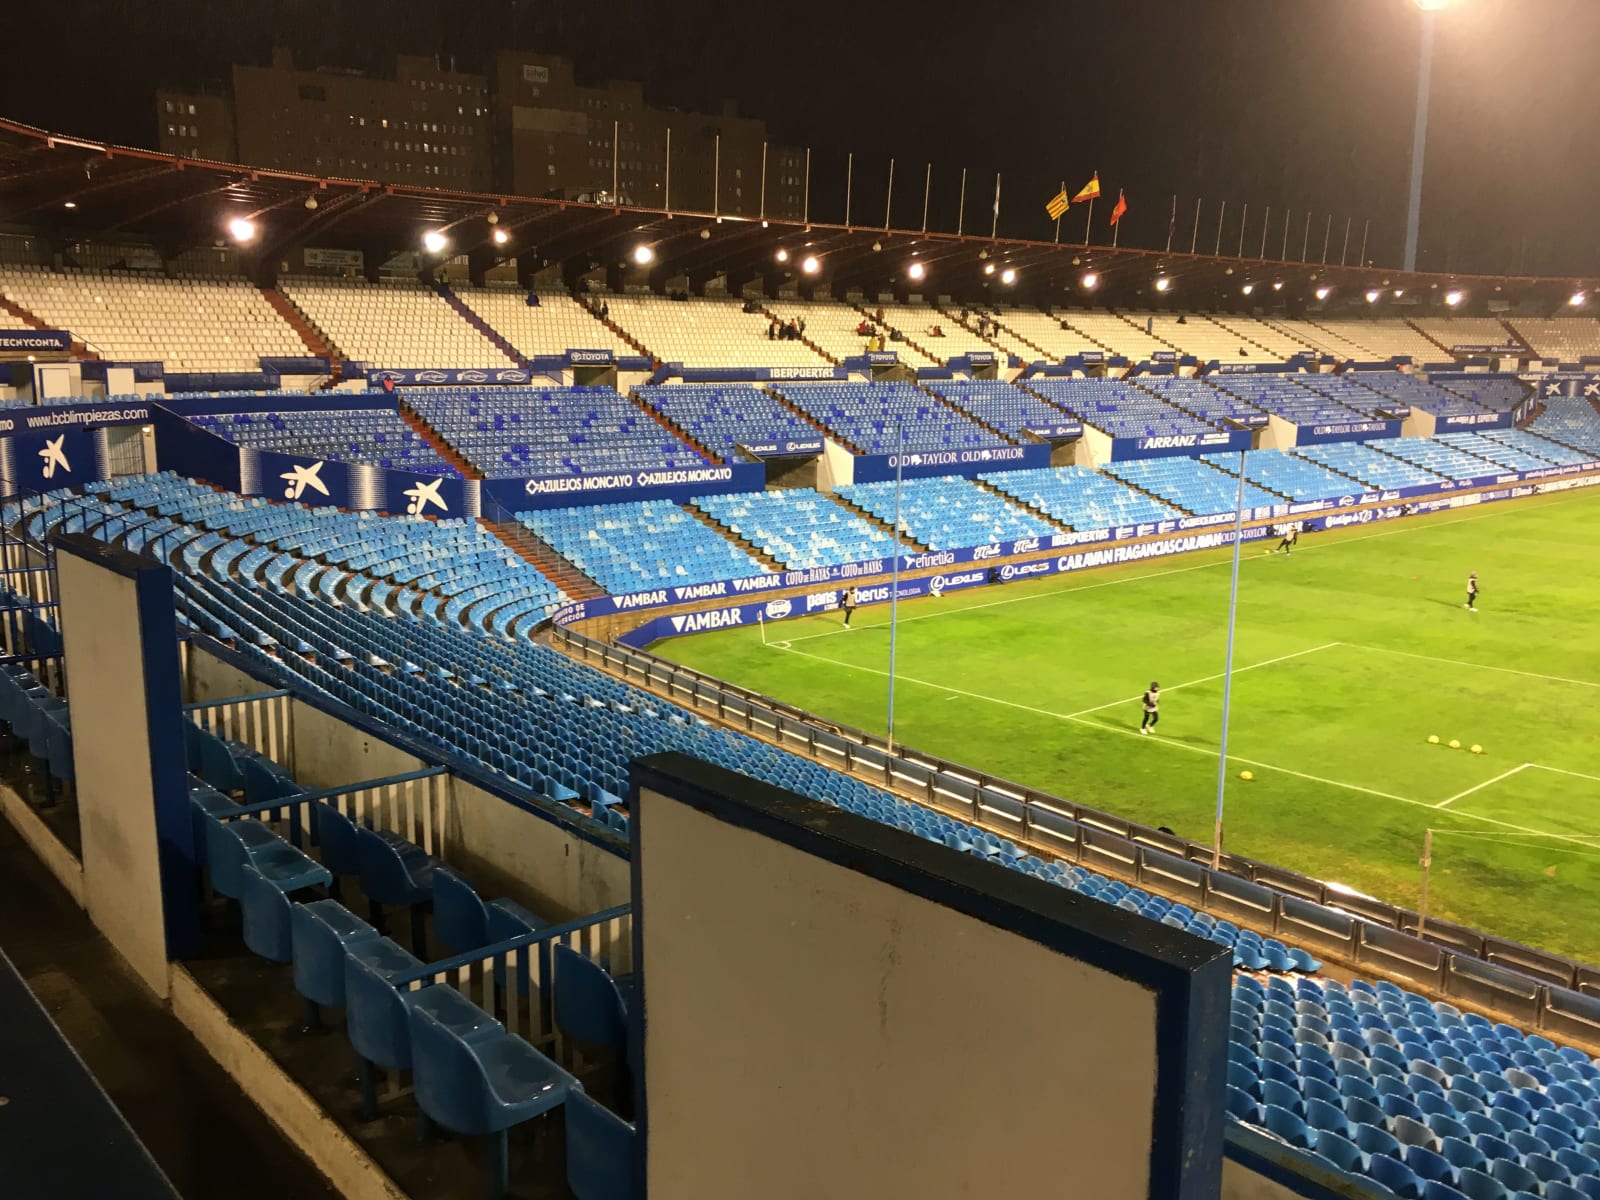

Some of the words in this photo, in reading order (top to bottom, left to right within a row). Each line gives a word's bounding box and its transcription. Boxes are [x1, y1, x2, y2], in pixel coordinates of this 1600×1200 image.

[770, 368, 834, 380] IBERPUERTAS
[27, 407, 149, 428] www.bcblimpiezas.com
[1143, 435, 1197, 449] ARRANZ
[889, 455, 910, 467] OD
[922, 452, 957, 465] TAYLOR
[961, 450, 981, 462] OLD
[991, 447, 1024, 460] TAYLOR
[538, 477, 582, 493] AZULEJOS
[583, 474, 633, 490] MONCAYO
[648, 471, 686, 484] AZULEJOS
[686, 467, 732, 482] MONCAYO
[1243, 527, 1267, 539] TAYLOR
[916, 550, 955, 569] efinetika
[1058, 548, 1113, 571] CARAVAN
[1114, 540, 1175, 563] FRAGANCIAS
[1174, 532, 1222, 553] CARAVAN
[786, 570, 804, 586] COTO
[809, 567, 830, 582] HAYAS
[841, 563, 858, 578] COTO
[863, 560, 883, 574] HAYAS
[741, 575, 781, 591] AMBAR
[945, 572, 984, 586] LEXUS
[623, 591, 668, 608] AMBAR
[684, 582, 727, 599] AMBAR
[807, 591, 837, 611] pans
[685, 607, 743, 632] AMBAR
